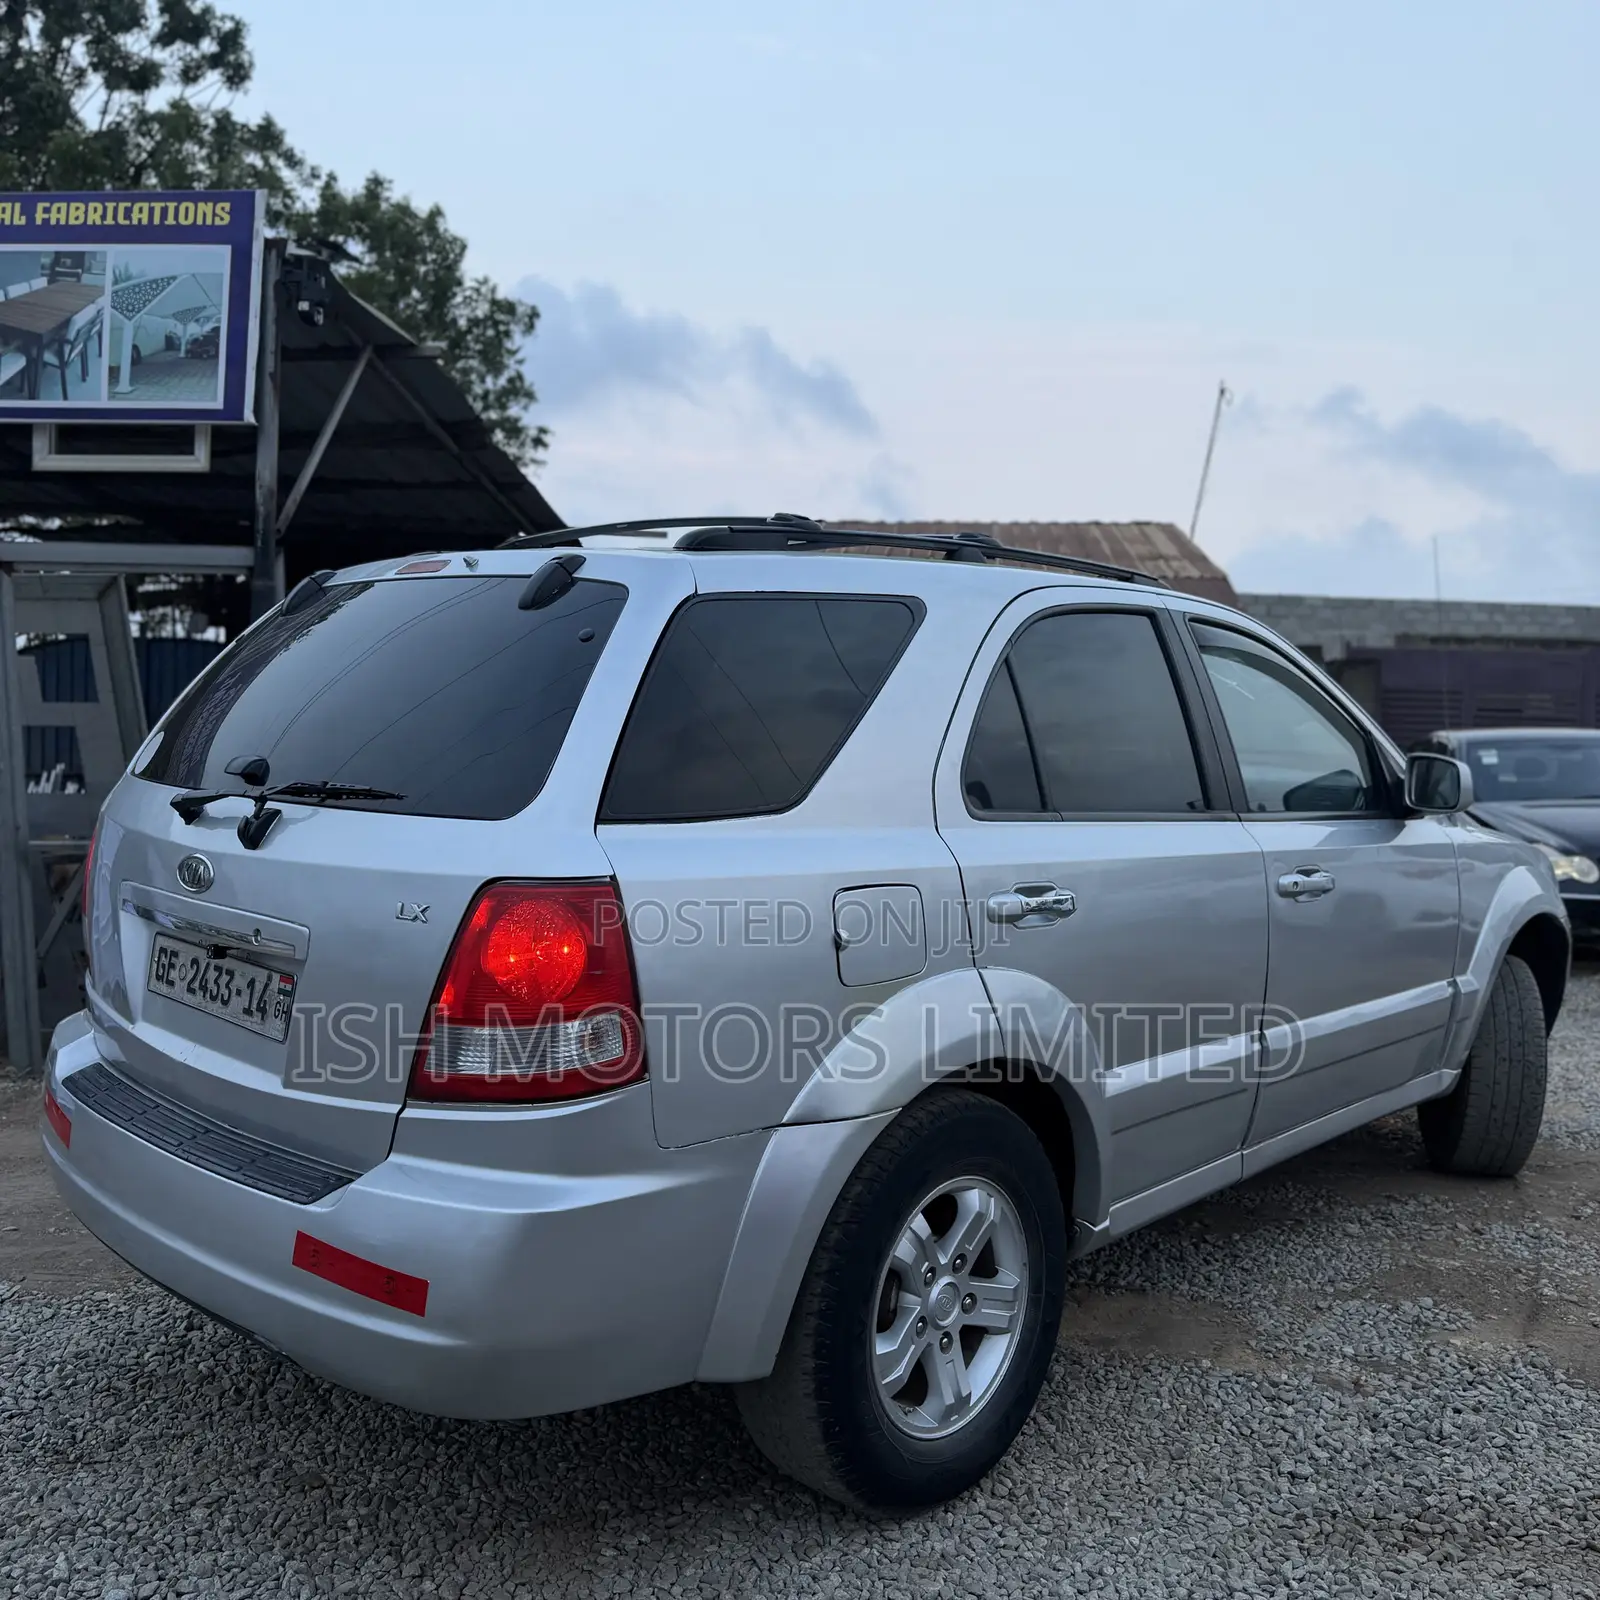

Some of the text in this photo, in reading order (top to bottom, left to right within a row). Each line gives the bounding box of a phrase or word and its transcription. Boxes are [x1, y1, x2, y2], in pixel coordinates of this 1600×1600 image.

[35, 202, 231, 226] FABRICATIONS
[395, 901, 431, 924] LX
[155, 946, 274, 1021] GE 2433-14
[273, 1001, 290, 1023] GH
